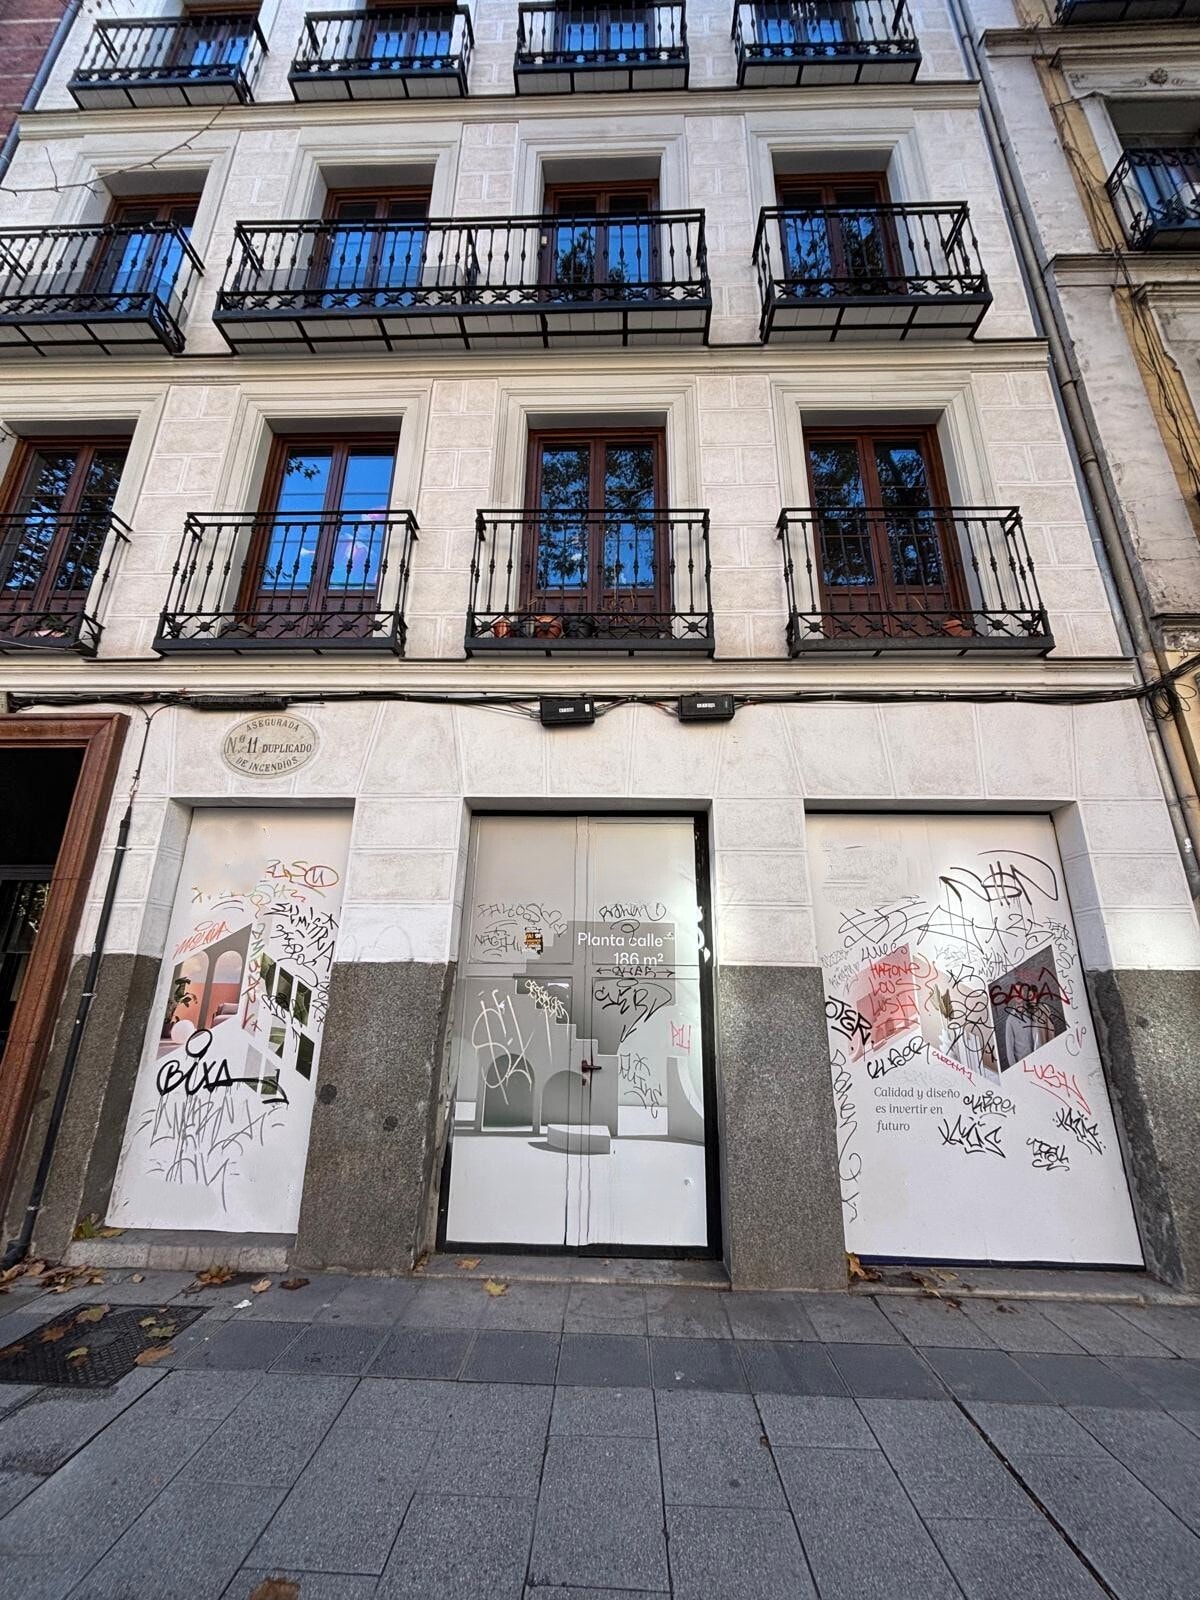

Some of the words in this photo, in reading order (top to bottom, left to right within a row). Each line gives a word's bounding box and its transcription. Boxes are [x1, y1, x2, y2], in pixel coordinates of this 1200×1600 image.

[246, 719, 299, 732] ASEGURADA
[246, 736, 259, 754] 11
[261, 744, 312, 753] DUPLICADO
[236, 757, 248, 767] DE
[249, 757, 298, 772] INCENDIOS
[577, 931, 626, 947] Planta
[628, 932, 664, 948] calle
[613, 952, 640, 966] 186
[873, 1086, 915, 1099] Calidad
[916, 1089, 925, 1102] y
[926, 1086, 961, 1099] diseño
[875, 1104, 887, 1114] es
[888, 1102, 928, 1115] invertir
[929, 1105, 944, 1115] en
[876, 1118, 911, 1134] futuro
